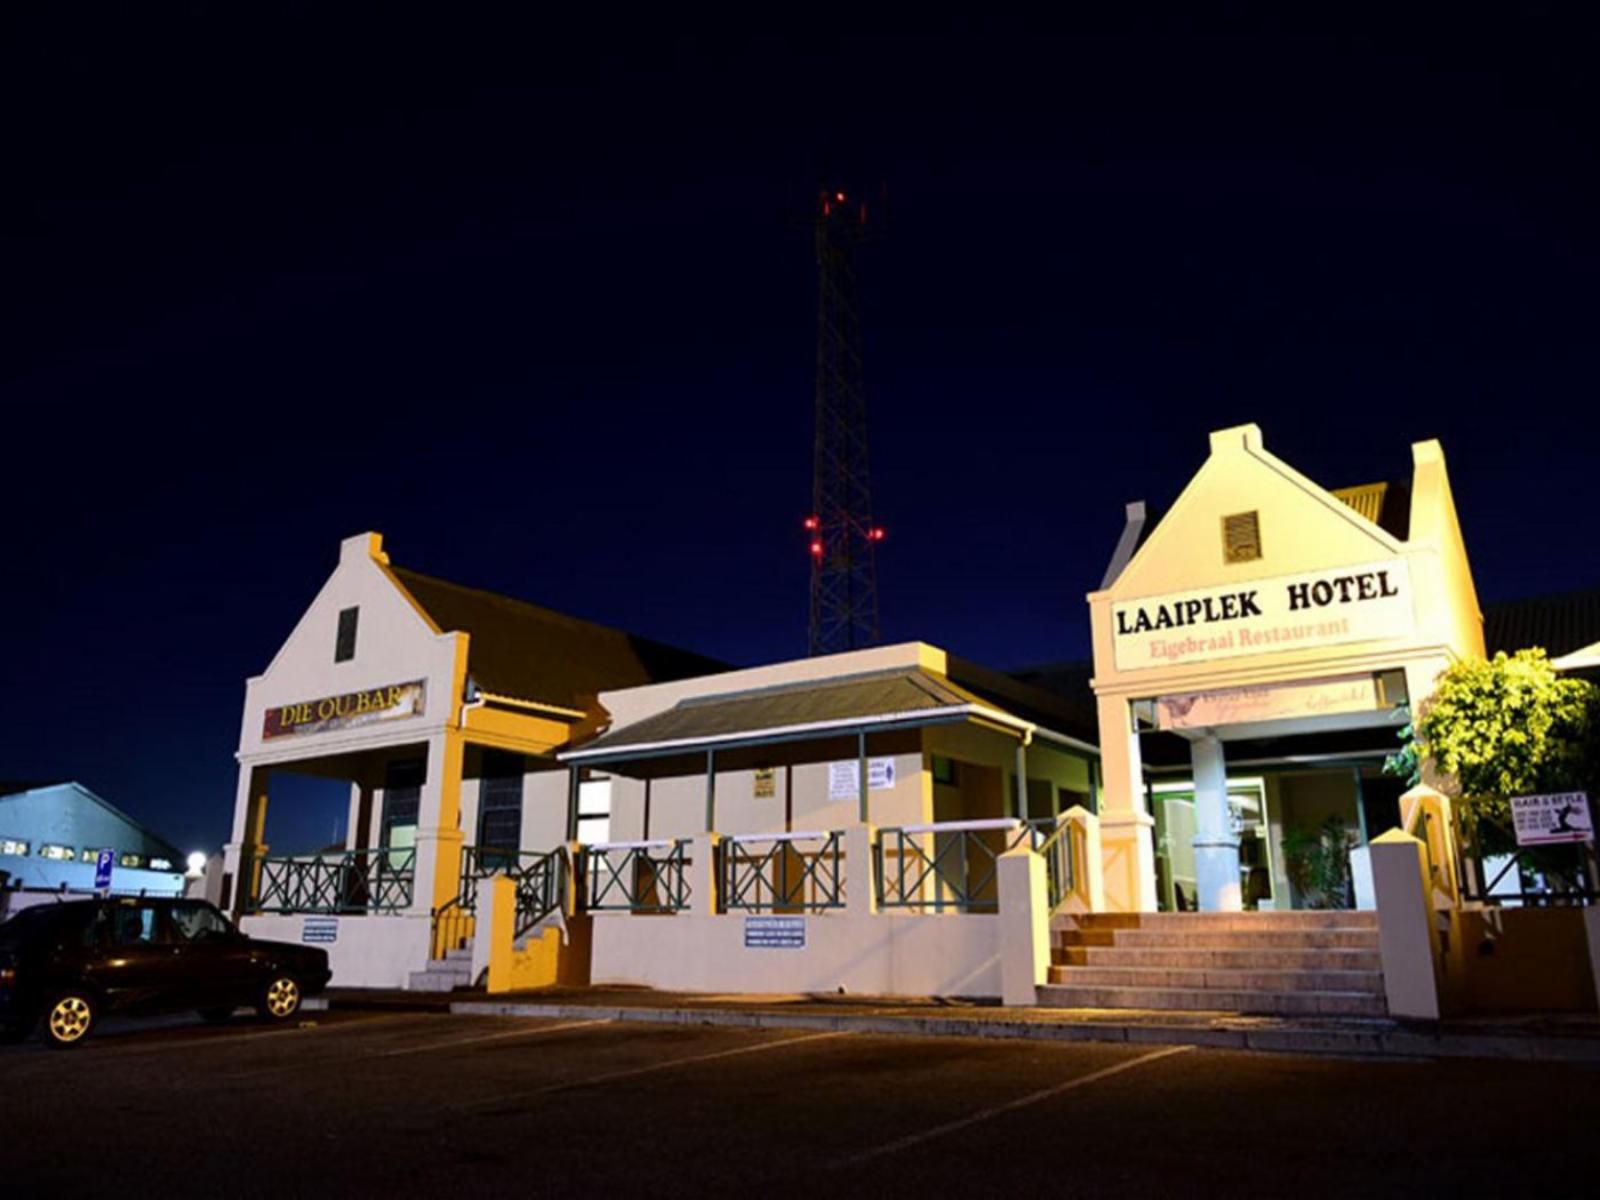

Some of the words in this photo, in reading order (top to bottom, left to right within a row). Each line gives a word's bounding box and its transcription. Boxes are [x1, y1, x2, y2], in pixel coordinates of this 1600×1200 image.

[1116, 591, 1262, 634] LAAIPLEK
[1287, 571, 1398, 611] HOTEL
[1238, 618, 1349, 646] Restaurant
[279, 703, 313, 727] DIE
[356, 686, 401, 713] BAR
[101, 853, 110, 869] P
